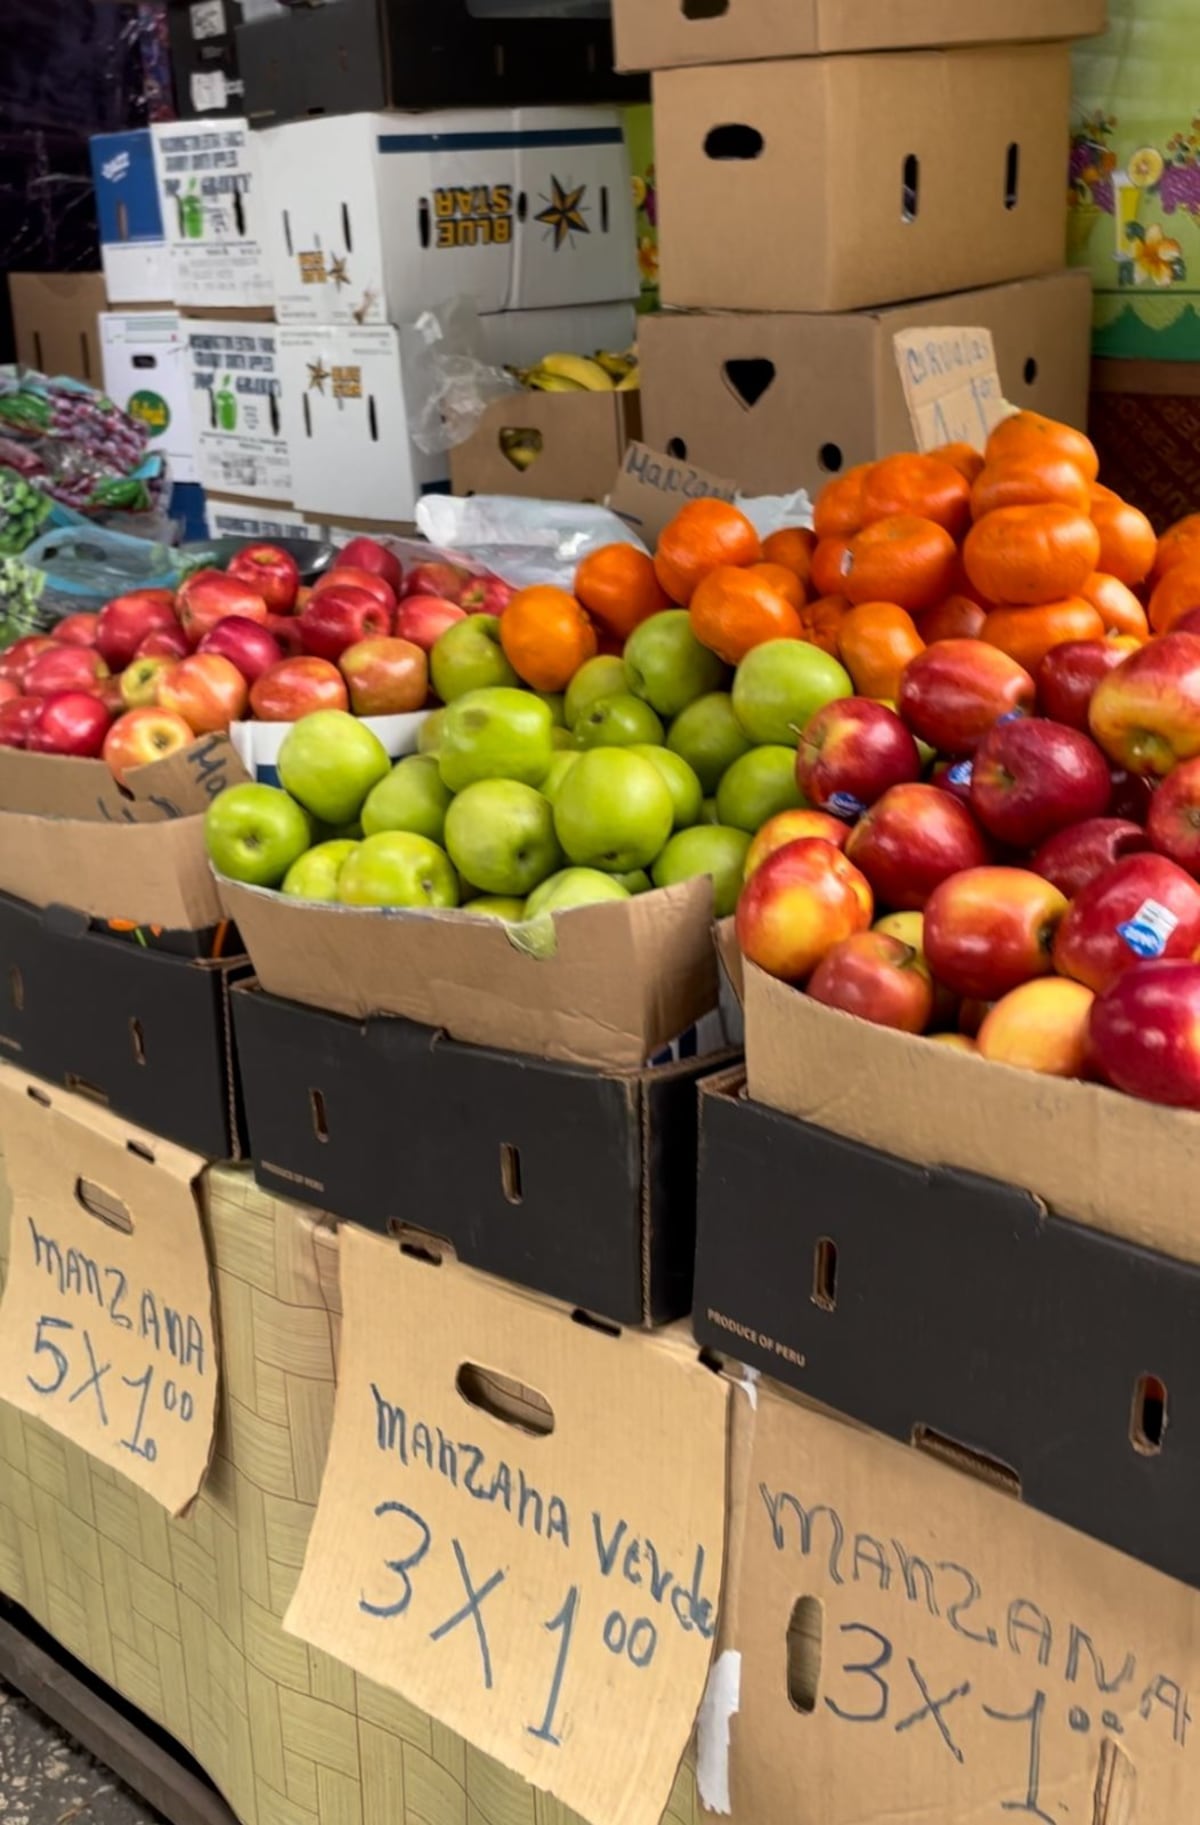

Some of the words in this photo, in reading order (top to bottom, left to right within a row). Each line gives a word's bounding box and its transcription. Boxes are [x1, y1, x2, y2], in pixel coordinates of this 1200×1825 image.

[434, 185, 512, 217] STAR
[436, 215, 512, 248] BLUE
[707, 1308, 757, 1344] PRODUCE
[758, 1333, 774, 1351] OF
[775, 1342, 806, 1368] PERU
